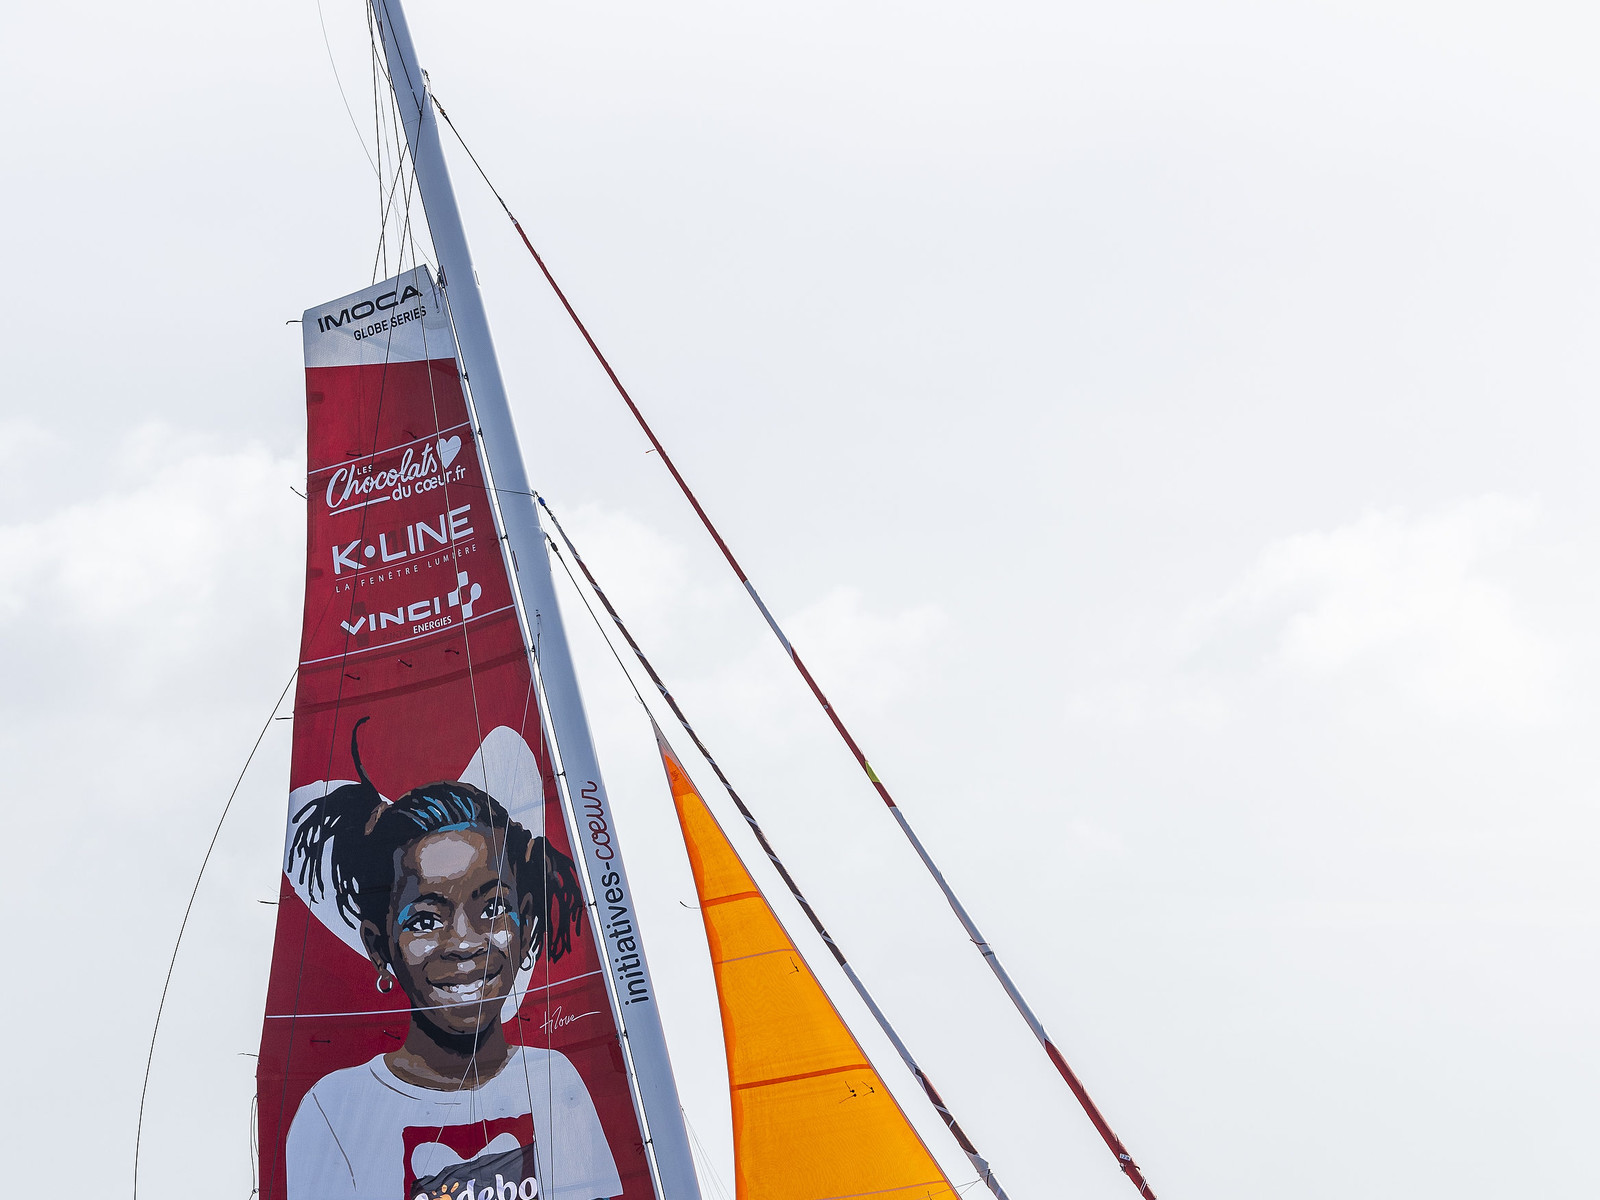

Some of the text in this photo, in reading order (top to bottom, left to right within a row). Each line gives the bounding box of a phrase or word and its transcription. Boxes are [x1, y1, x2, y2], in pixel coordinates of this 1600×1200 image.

[317, 285, 423, 333] IMOCA
[353, 305, 427, 341] GLOBE SERIES
[326, 442, 438, 509] Chocolats
[357, 465, 373, 475] LES
[391, 481, 412, 501] du
[335, 583, 350, 593] LA
[340, 597, 440, 636] VINCI
[413, 615, 452, 634] ENERGIES
